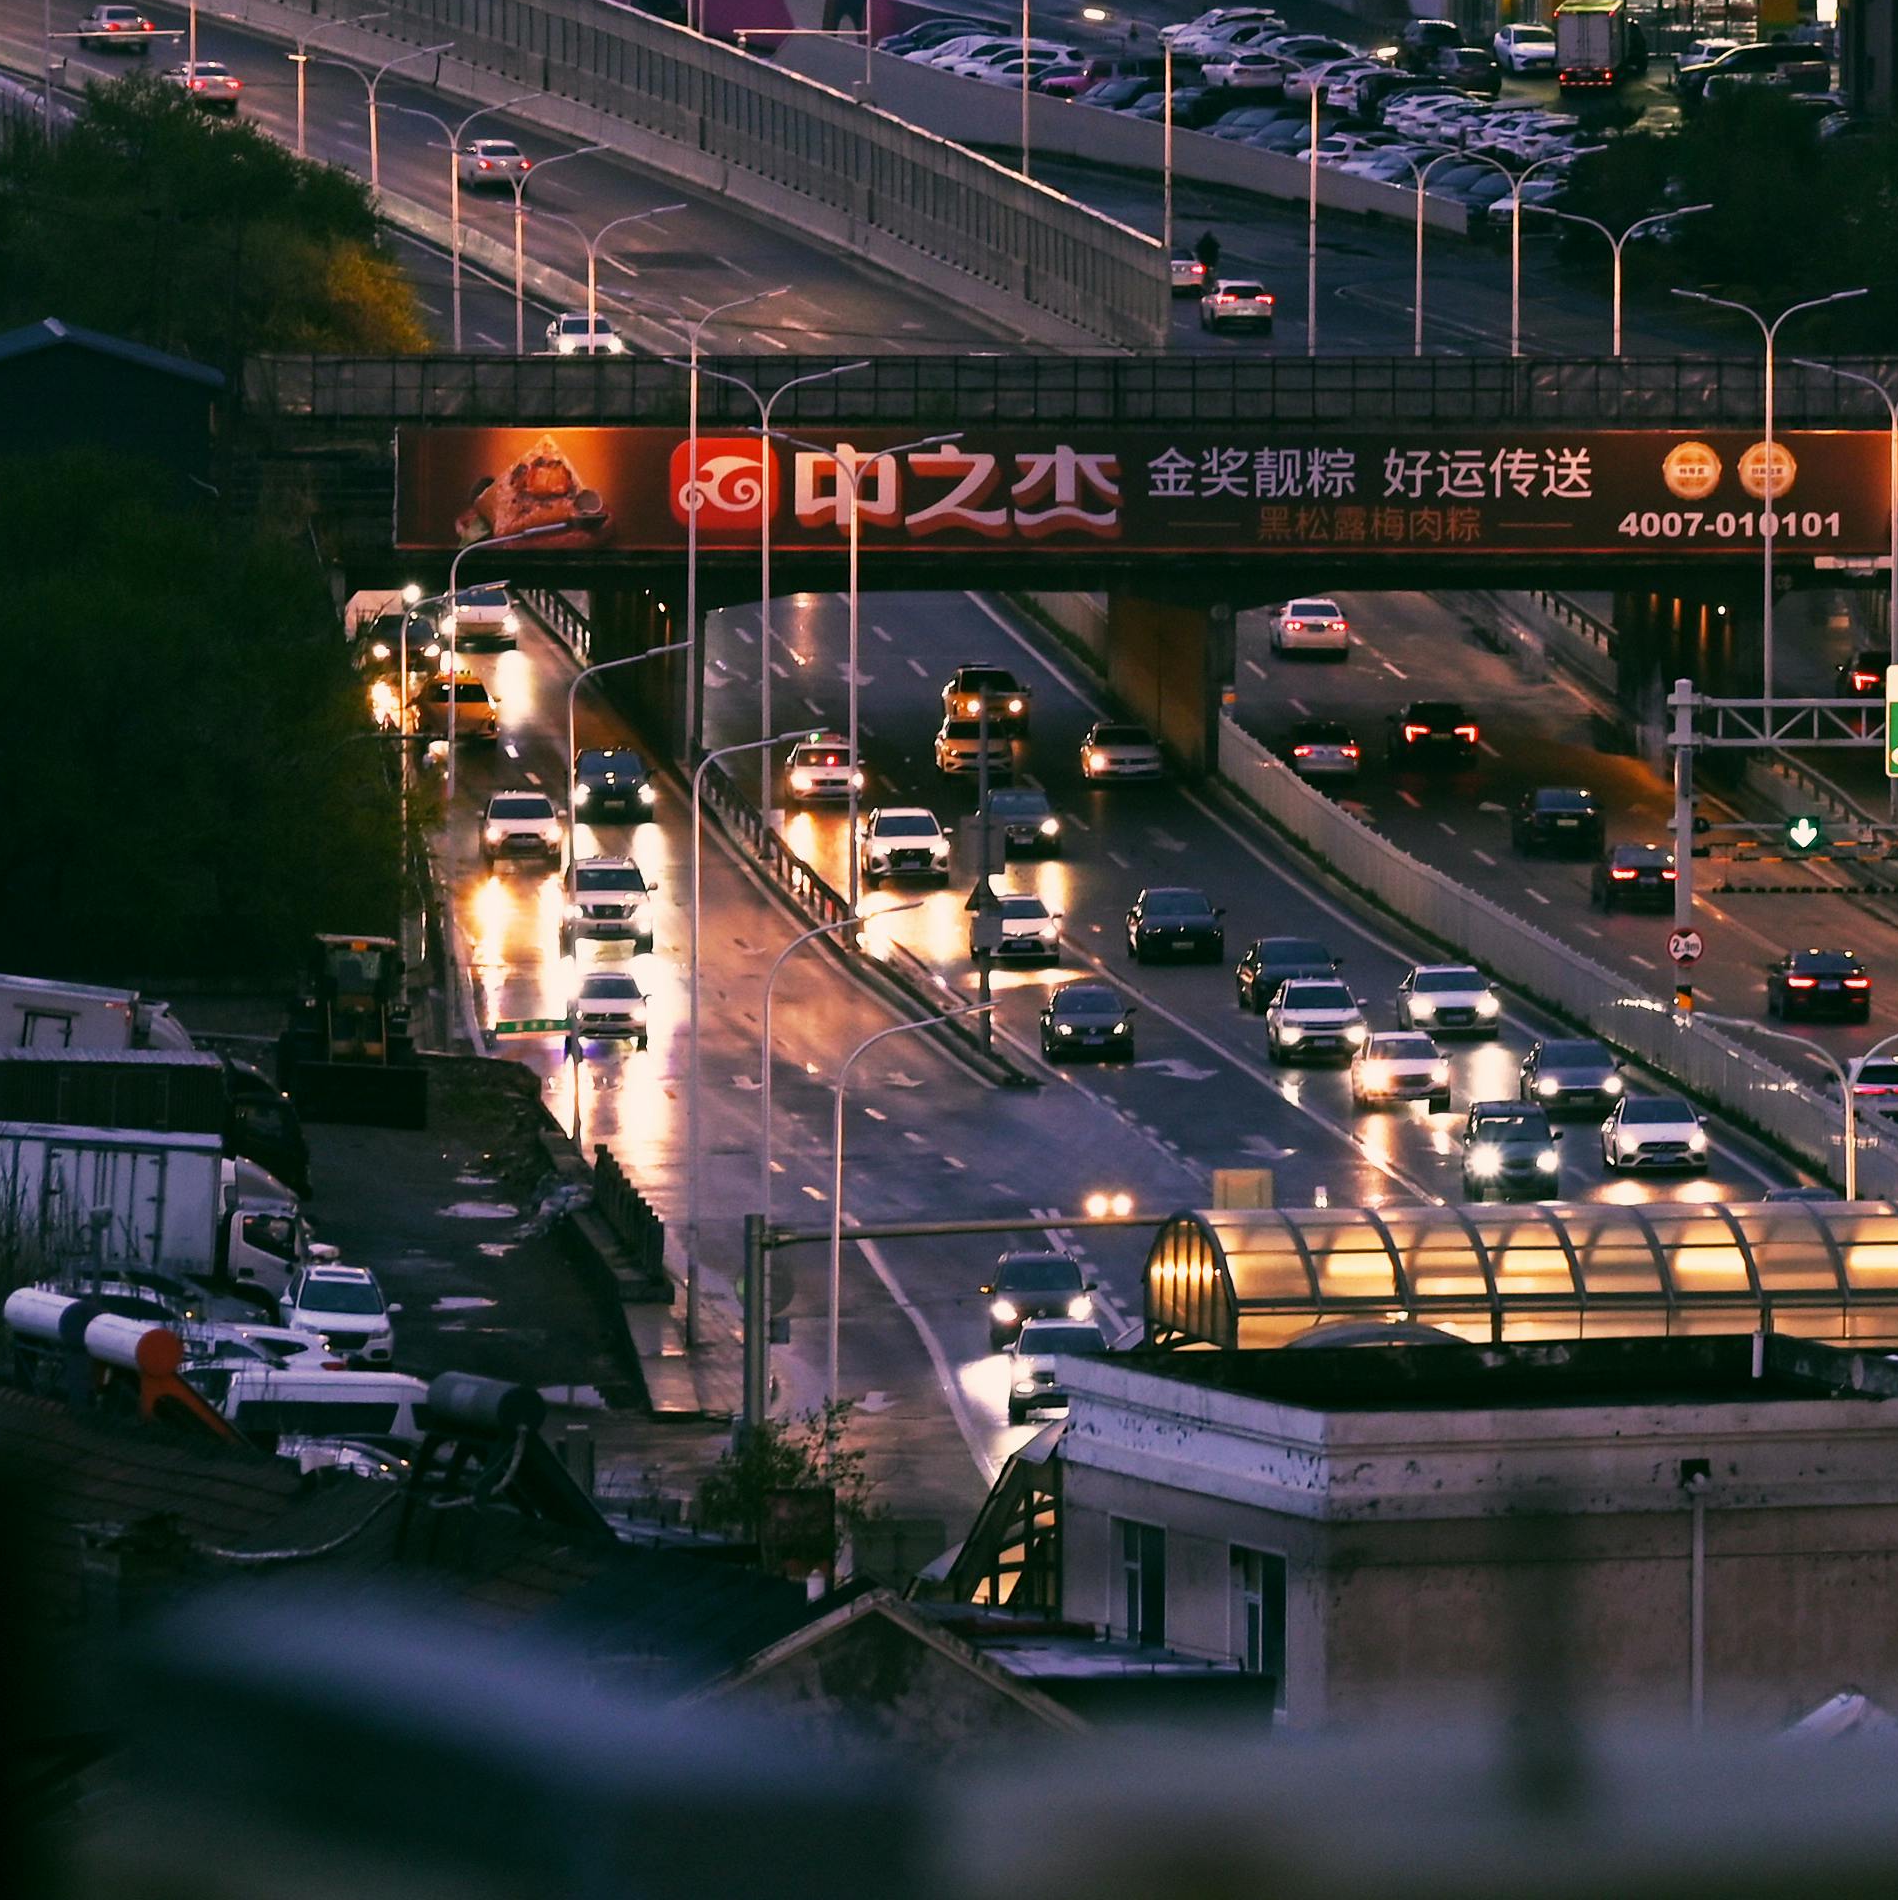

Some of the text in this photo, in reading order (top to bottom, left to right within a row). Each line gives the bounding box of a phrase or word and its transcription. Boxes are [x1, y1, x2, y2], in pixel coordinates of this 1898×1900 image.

[794, 443, 1121, 530] 中之杰
[1146, 446, 1593, 499] 金奖靓粽 好运传送
[1258, 506, 1482, 542] 黑松露梅肉粽
[1617, 511, 1841, 538] 4007-010101
[1672, 938, 1700, 953] 2.9m
